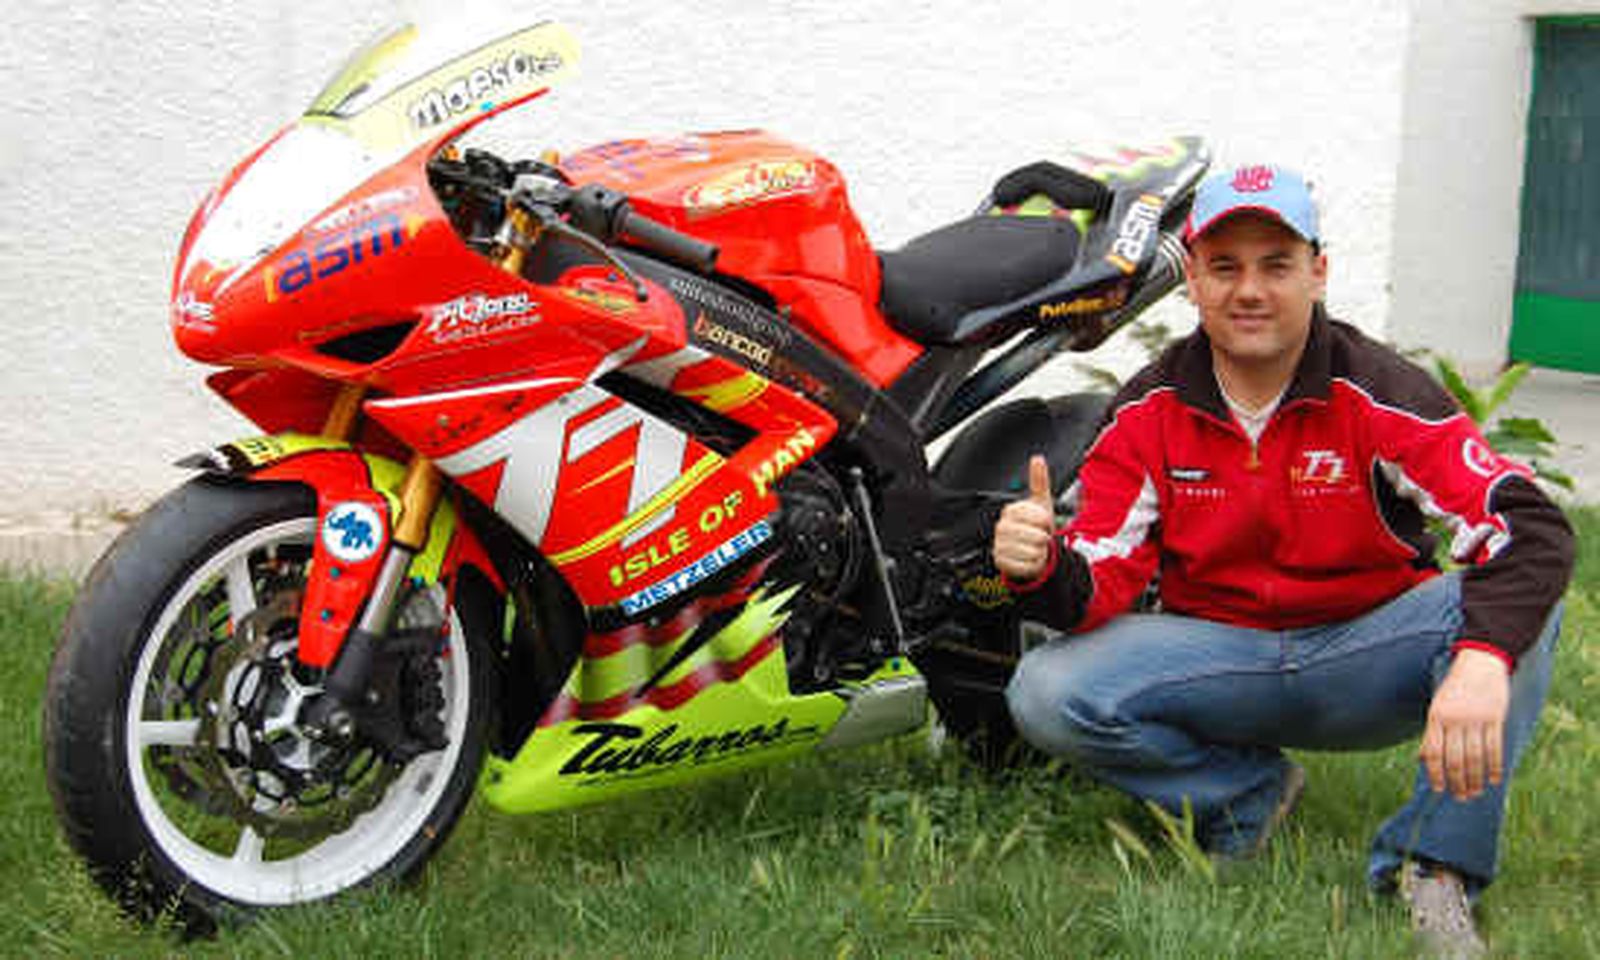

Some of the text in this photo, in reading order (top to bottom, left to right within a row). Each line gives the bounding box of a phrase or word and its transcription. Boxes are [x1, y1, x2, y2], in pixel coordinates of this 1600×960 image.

[278, 214, 403, 293] asm
[609, 429, 815, 586] ISLE OF MAN
[622, 521, 772, 613] METZELER
